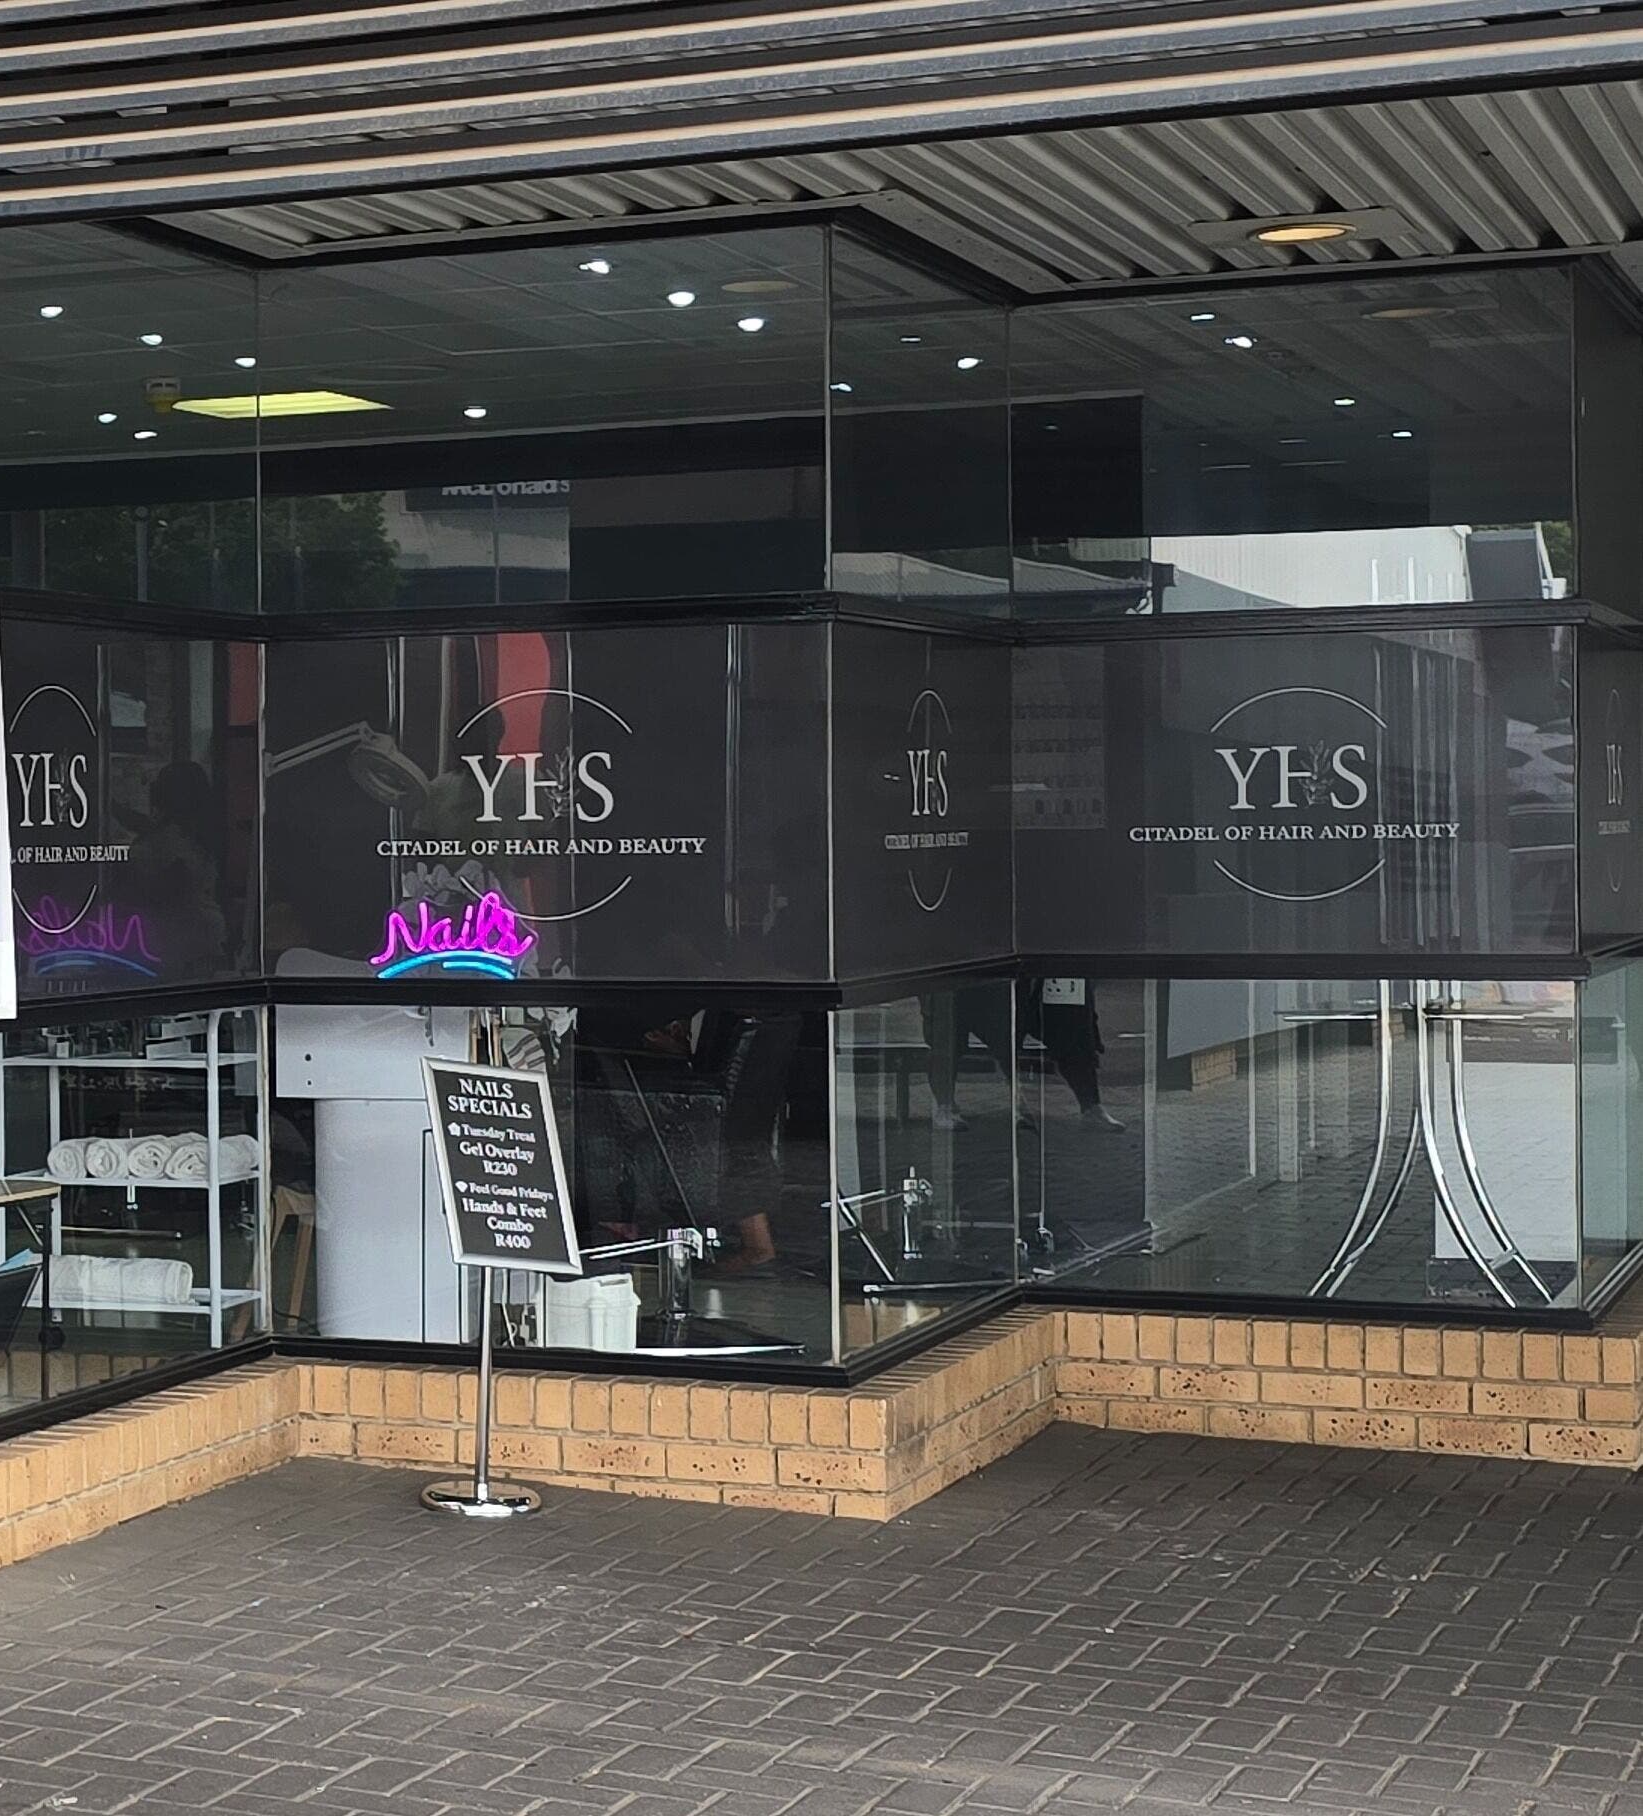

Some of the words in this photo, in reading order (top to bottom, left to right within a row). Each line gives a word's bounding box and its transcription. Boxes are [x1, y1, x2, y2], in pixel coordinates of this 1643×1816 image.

[1129, 826, 1220, 842] CITADEL
[1224, 825, 1254, 841] OF
[1257, 825, 1315, 841] HAIR
[1319, 824, 1367, 839] AND
[1372, 822, 1461, 839] BEAUTY
[17, 846, 33, 863] OF
[34, 846, 63, 863] HAIR
[64, 846, 88, 862] AND
[90, 845, 130, 862] BEAUTY
[377, 840, 466, 857] CITADEL
[471, 840, 500, 856] OF
[504, 839, 560, 855] HAIR
[565, 838, 613, 855] AND
[618, 837, 707, 854] BEAUTY
[370, 891, 534, 966] Nails
[458, 1078, 514, 1099] NAILS
[447, 1095, 532, 1119] SPECIALS
[461, 1123, 506, 1142] Tuesday
[506, 1128, 536, 1143] Treat
[459, 1141, 484, 1156] Gel
[485, 1143, 534, 1164] Overlay
[482, 1160, 518, 1176] R230
[462, 1198, 504, 1215] Hands
[506, 1202, 518, 1216] &
[519, 1203, 548, 1219] Feet
[486, 1216, 534, 1233] Combo
[494, 1233, 531, 1249] R400
